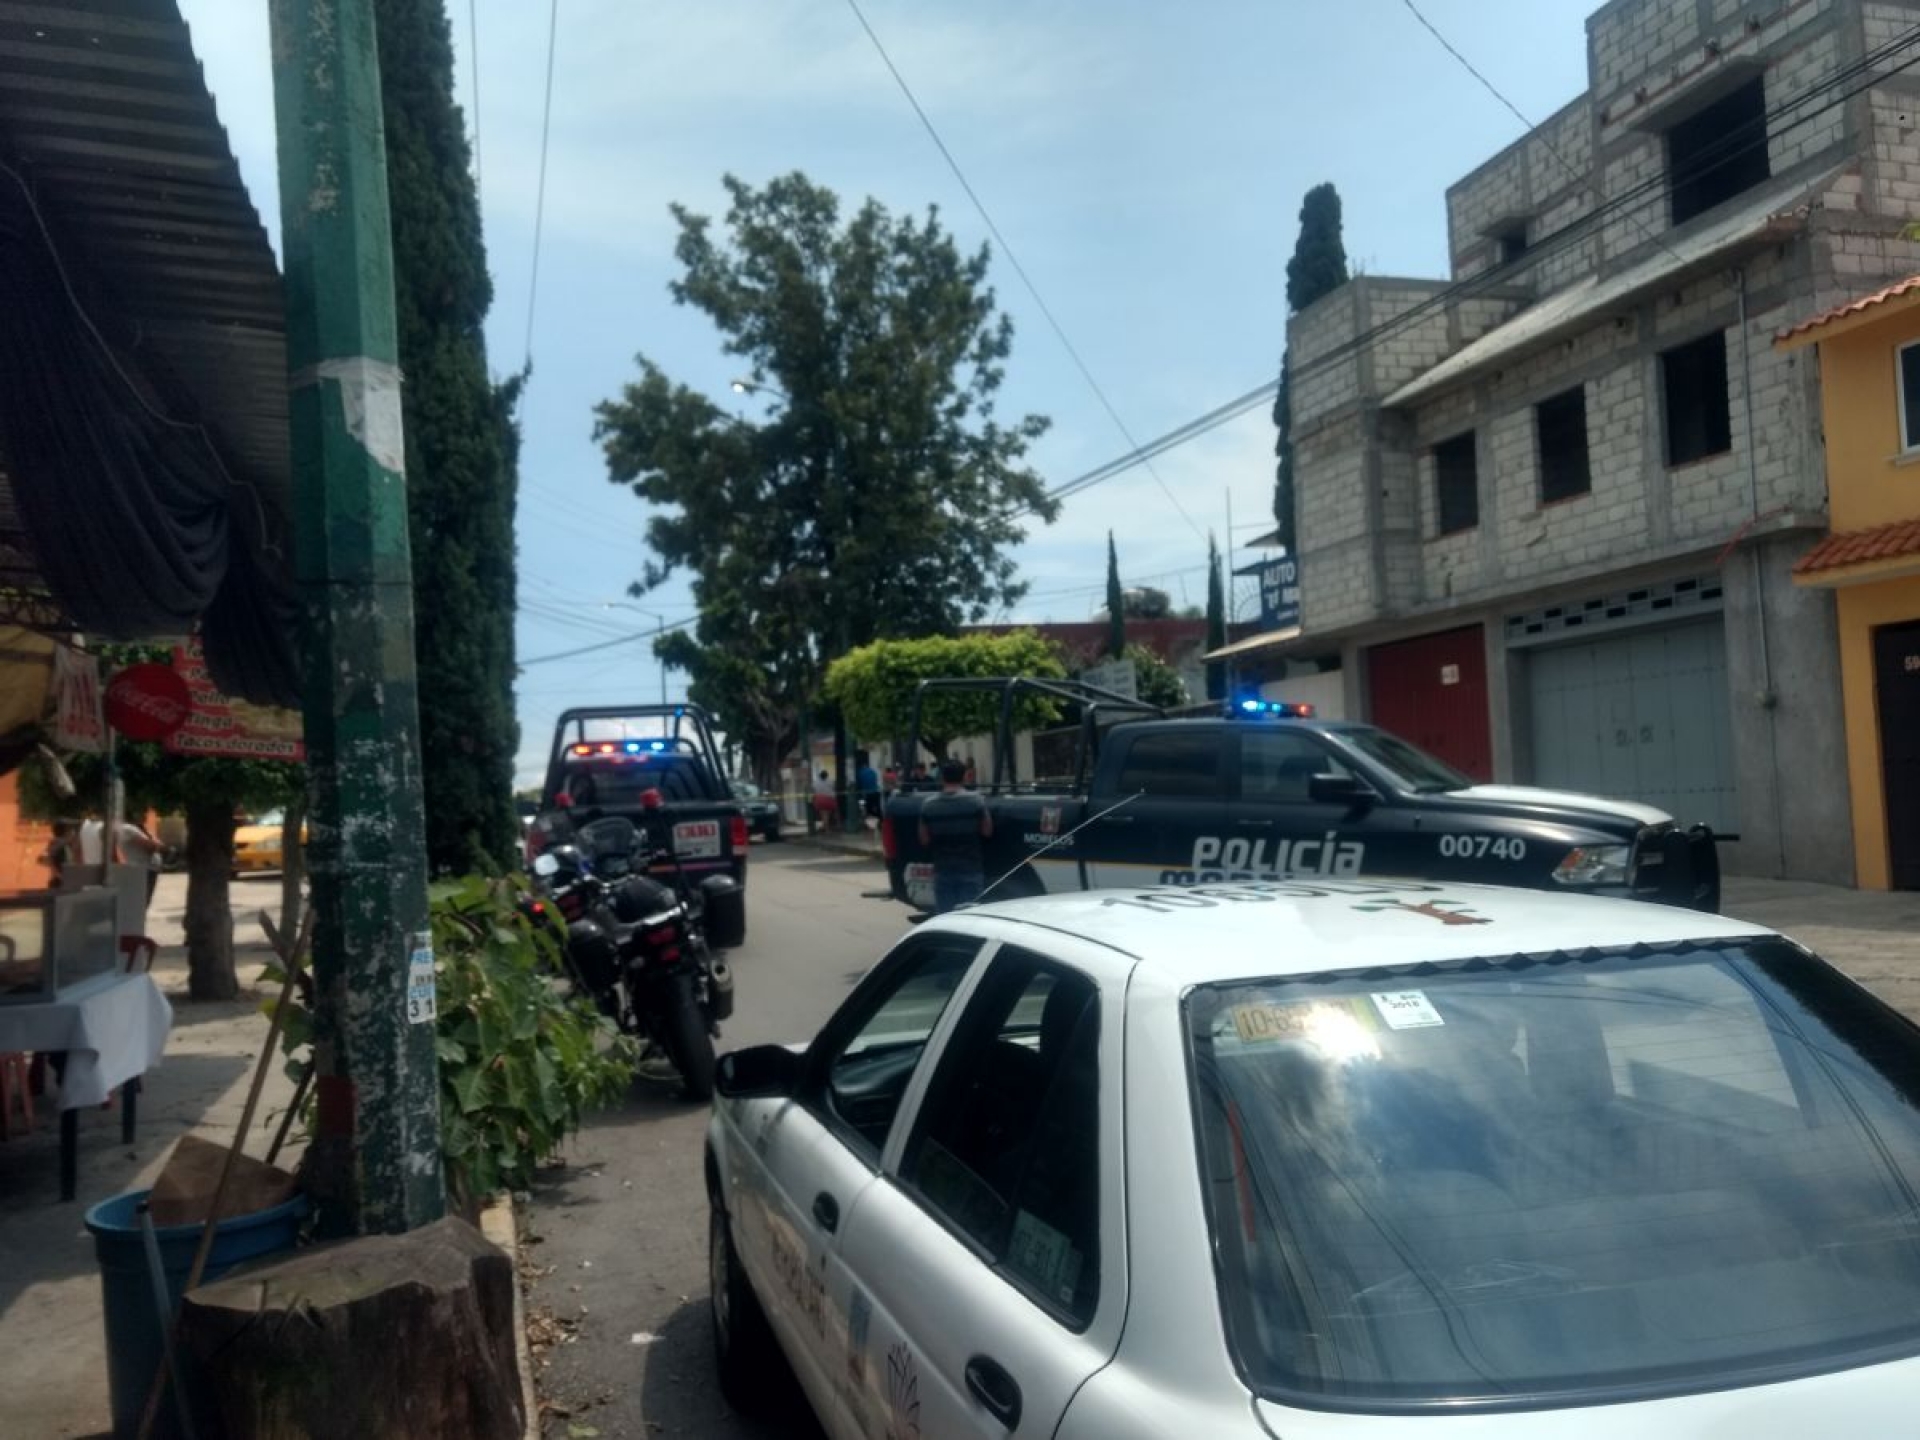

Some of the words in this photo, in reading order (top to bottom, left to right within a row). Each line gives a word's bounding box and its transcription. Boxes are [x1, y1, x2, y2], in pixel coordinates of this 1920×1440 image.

[1263, 562, 1296, 588] AUTO
[176, 733, 222, 749] Tacos
[225, 736, 296, 754] dorados
[1440, 834, 1526, 860] 00740
